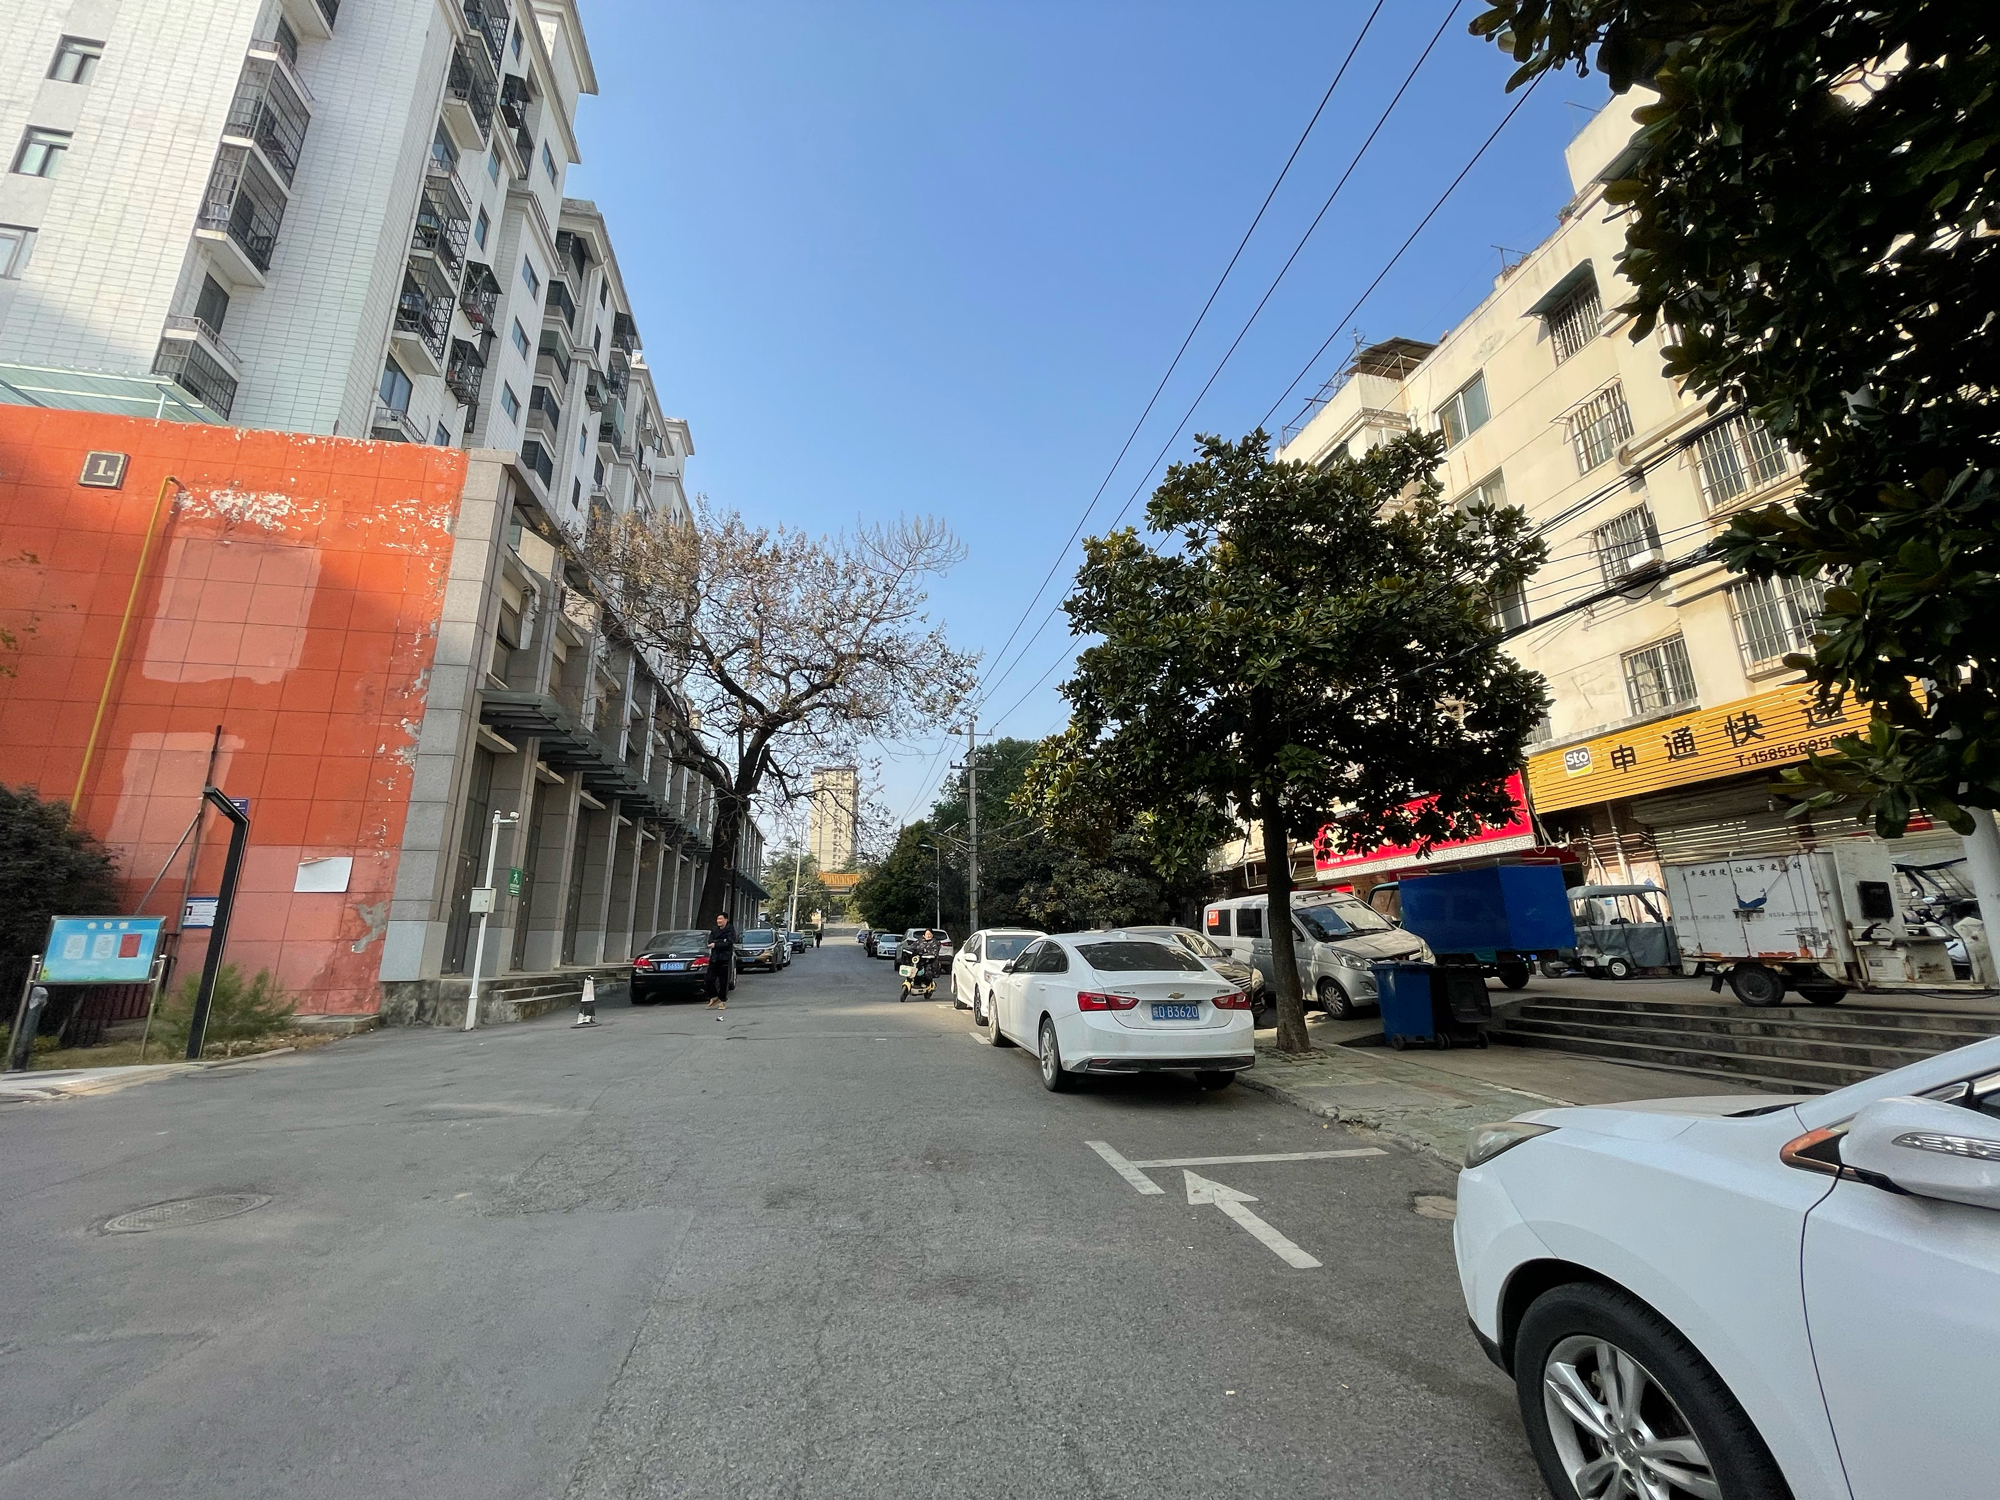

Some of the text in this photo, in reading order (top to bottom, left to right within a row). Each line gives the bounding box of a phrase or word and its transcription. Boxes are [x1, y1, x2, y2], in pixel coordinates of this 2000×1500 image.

[1734, 861, 1802, 874] 让城市更好
